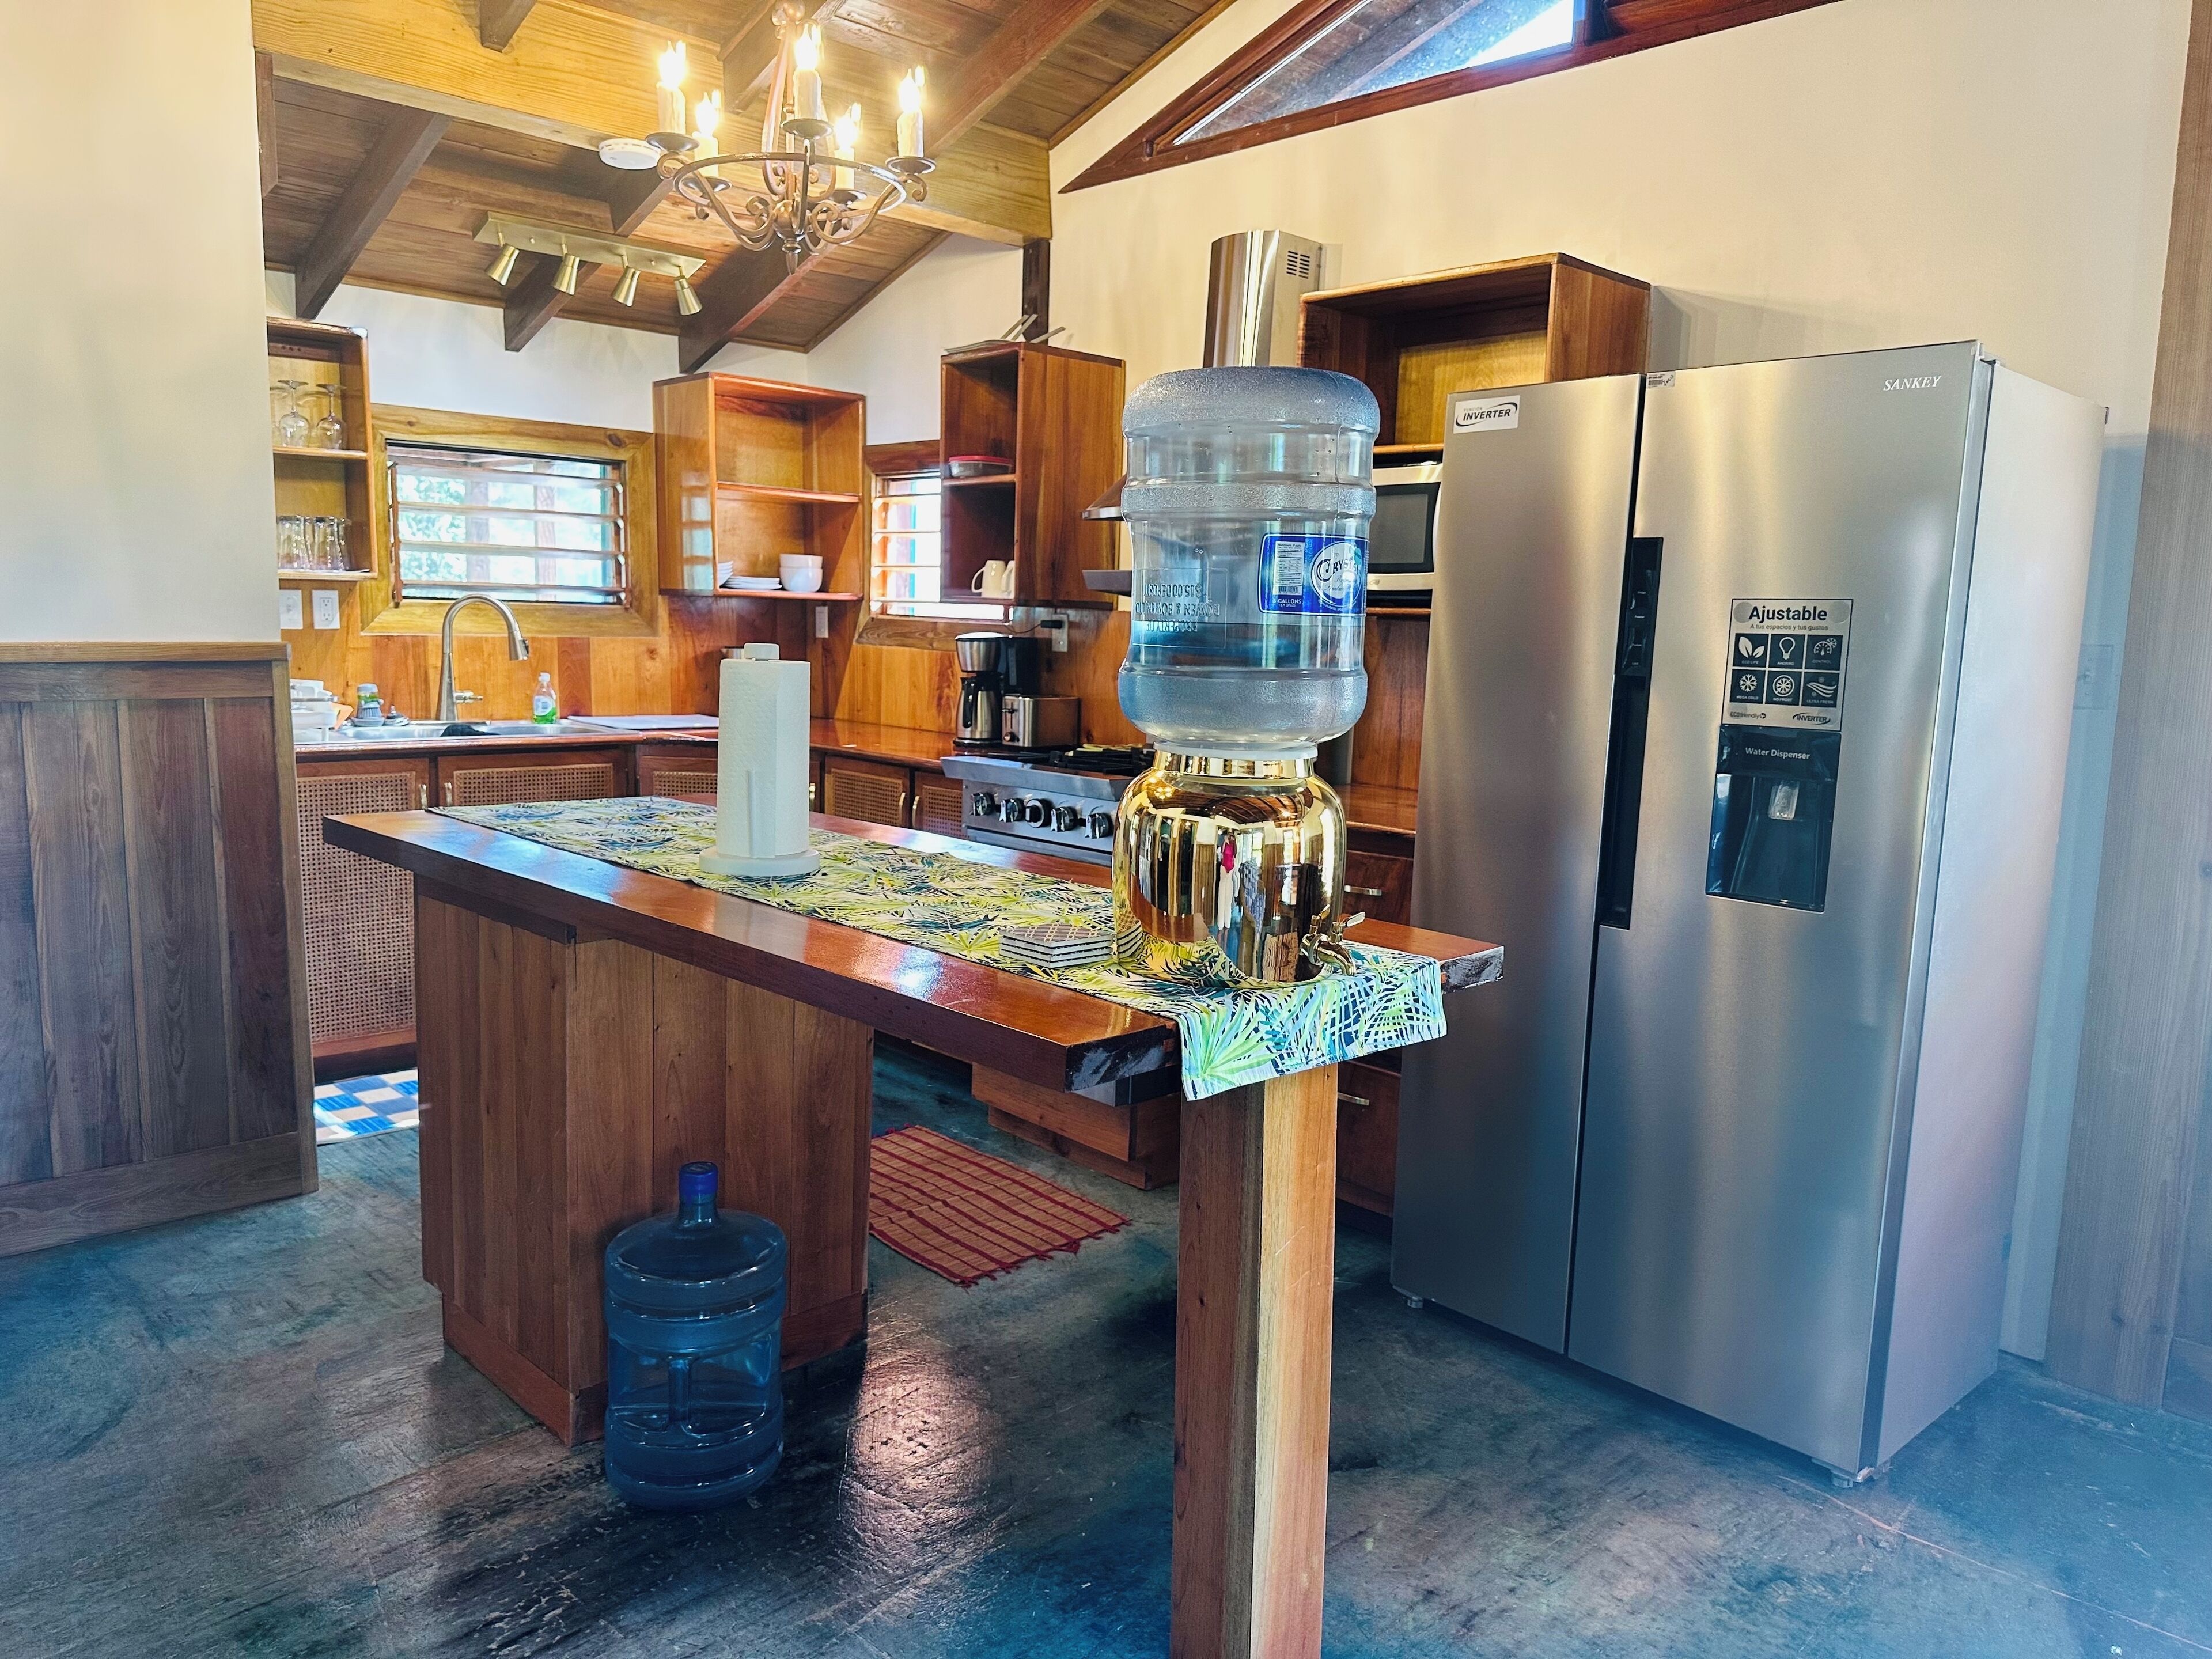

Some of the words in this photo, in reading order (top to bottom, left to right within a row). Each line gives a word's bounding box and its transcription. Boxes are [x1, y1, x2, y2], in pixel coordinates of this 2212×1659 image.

[1883, 376, 1941, 391] SANKEY
[1463, 409, 1510, 421] INVERTER
[1144, 584, 1171, 597] DEPOSIT
[1176, 603, 1181, 615] &
[1183, 603, 1220, 616] BOWEN
[1748, 605, 1827, 623] Ajustable
[1745, 747, 1770, 756] Water
[1771, 749, 1810, 759] Dispenser
